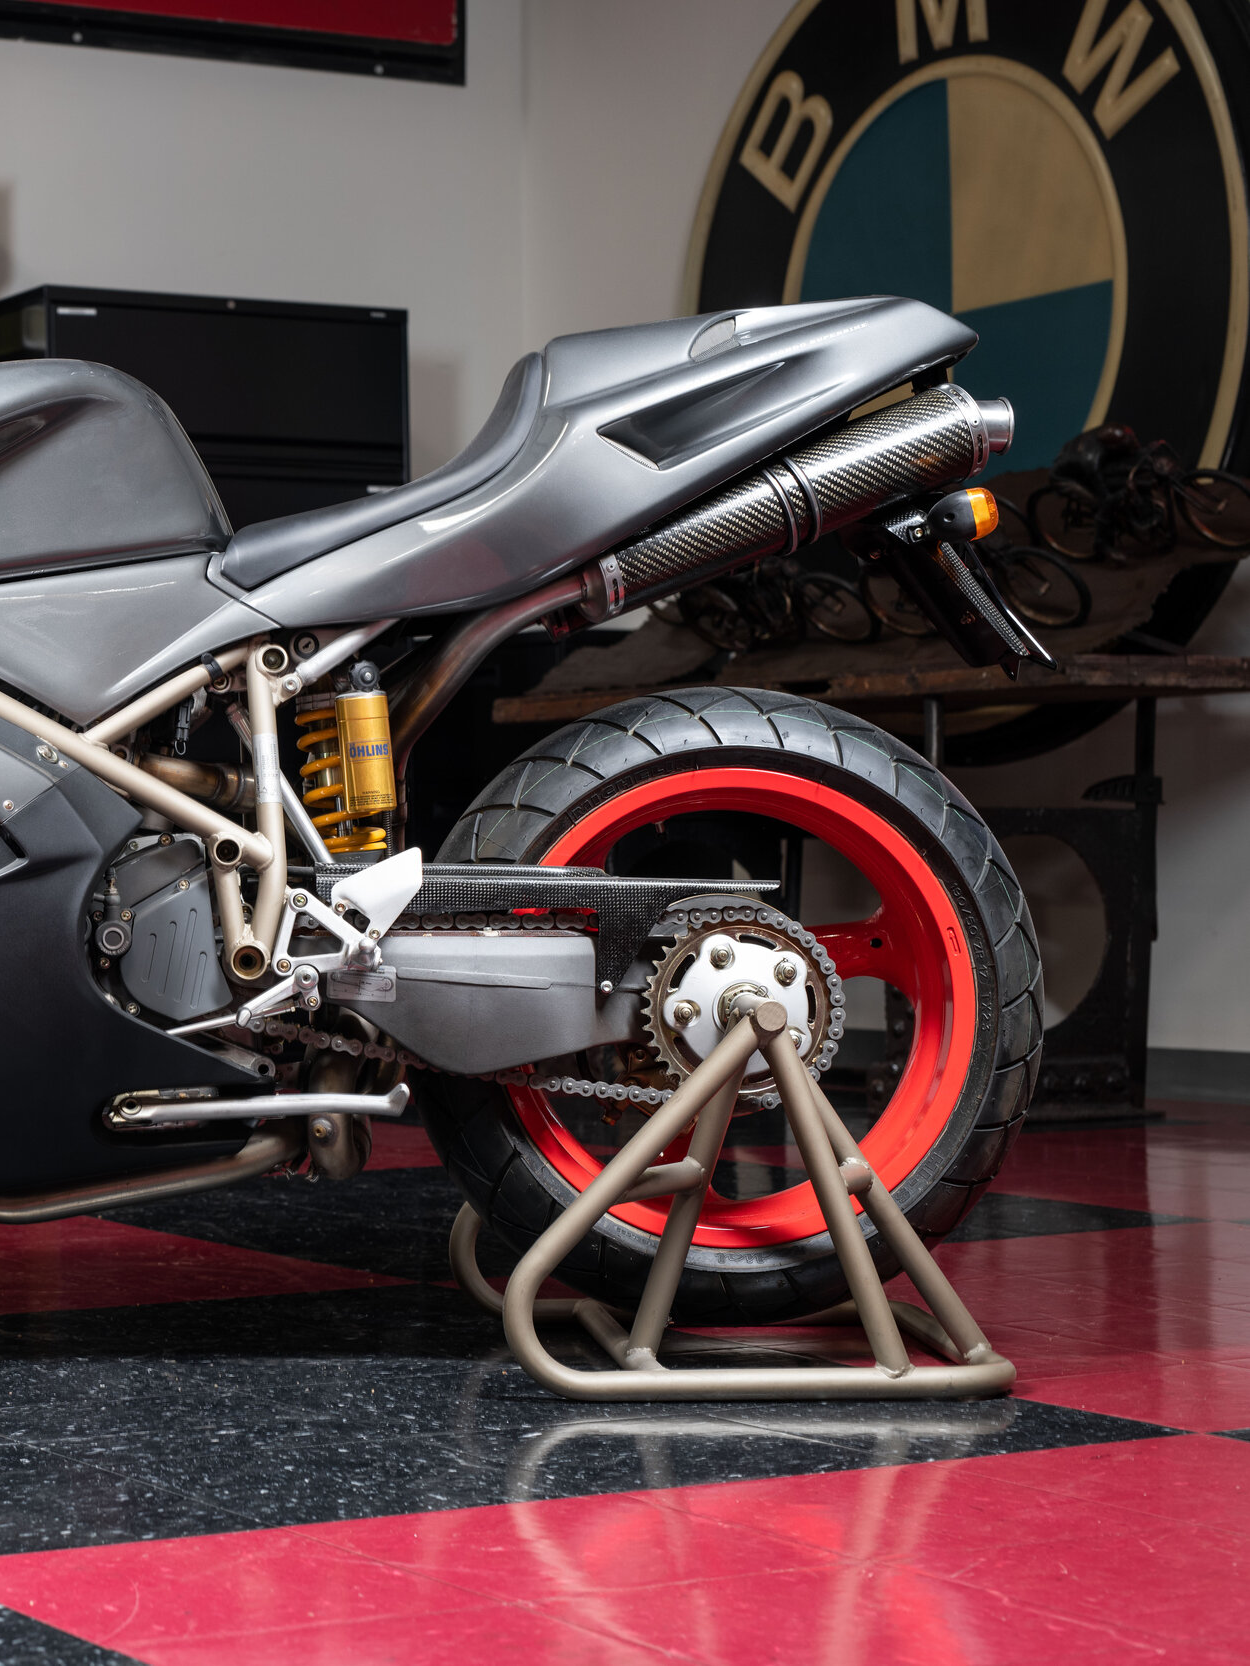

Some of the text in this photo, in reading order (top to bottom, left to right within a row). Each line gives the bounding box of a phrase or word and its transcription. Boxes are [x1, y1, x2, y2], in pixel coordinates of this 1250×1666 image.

[739, 0, 1180, 213] BMW
[349, 742, 390, 759] ÖHLINS
[570, 754, 694, 820] MICHELIN
[892, 1152, 946, 1206] HI-S
